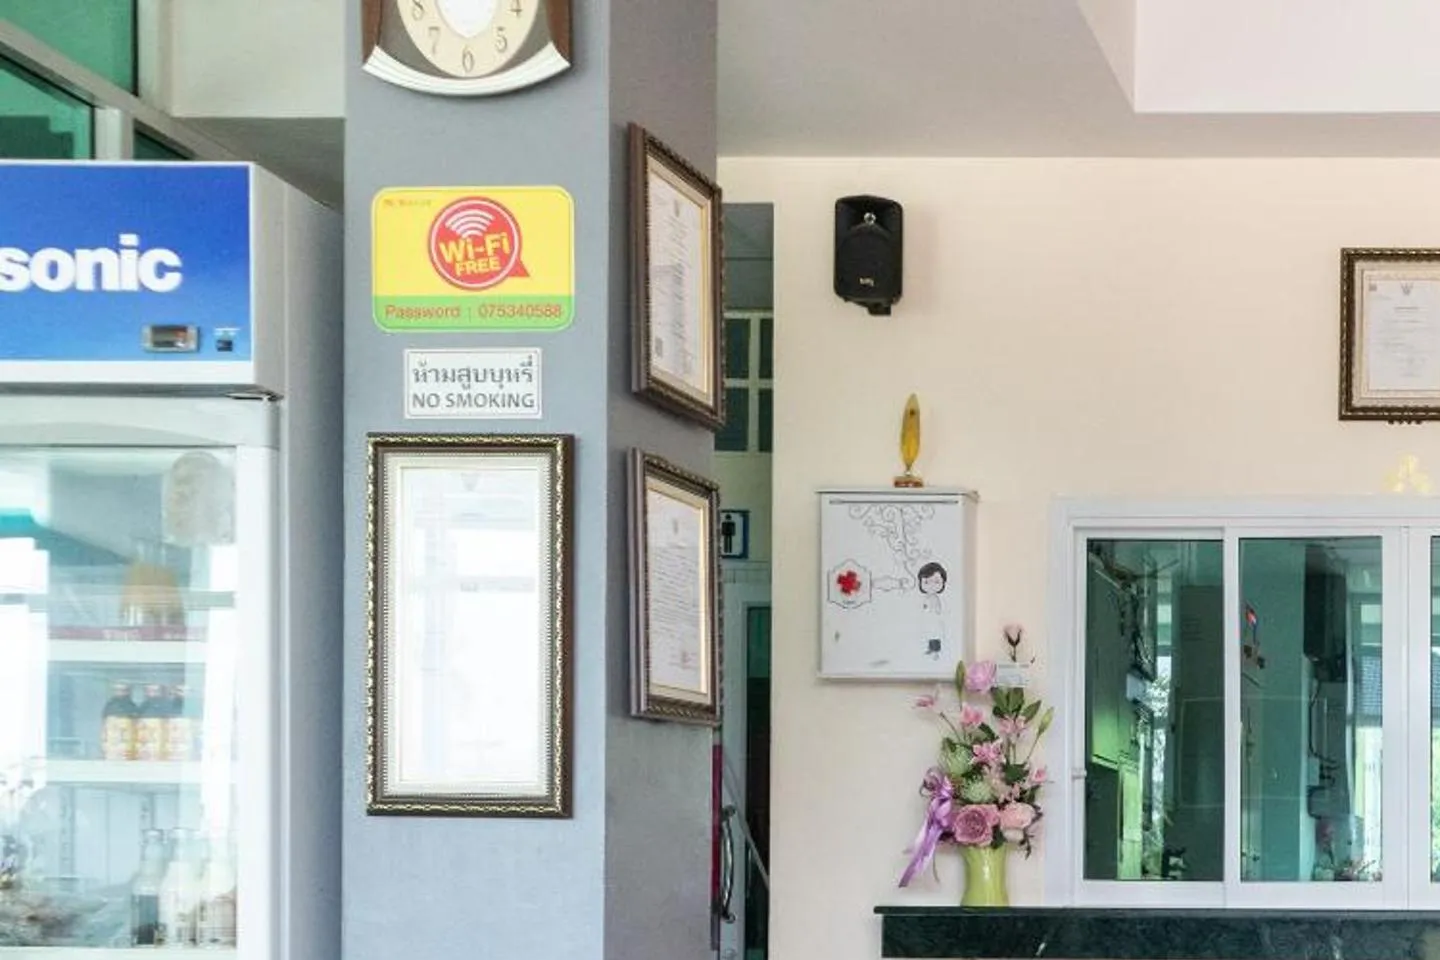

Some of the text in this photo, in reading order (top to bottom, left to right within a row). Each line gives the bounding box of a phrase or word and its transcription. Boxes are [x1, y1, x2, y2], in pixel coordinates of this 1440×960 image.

[510, 0, 522, 17] 4
[428, 26, 440, 54] 7
[496, 26, 508, 52] 5
[438, 232, 511, 264] Wi-Fi
[0, 233, 183, 292] sonic
[455, 256, 501, 277] FREE
[385, 304, 461, 321] Password
[412, 354, 534, 391] ห้ามสูบบุหรี่
[412, 392, 535, 409] NO SMOKING
